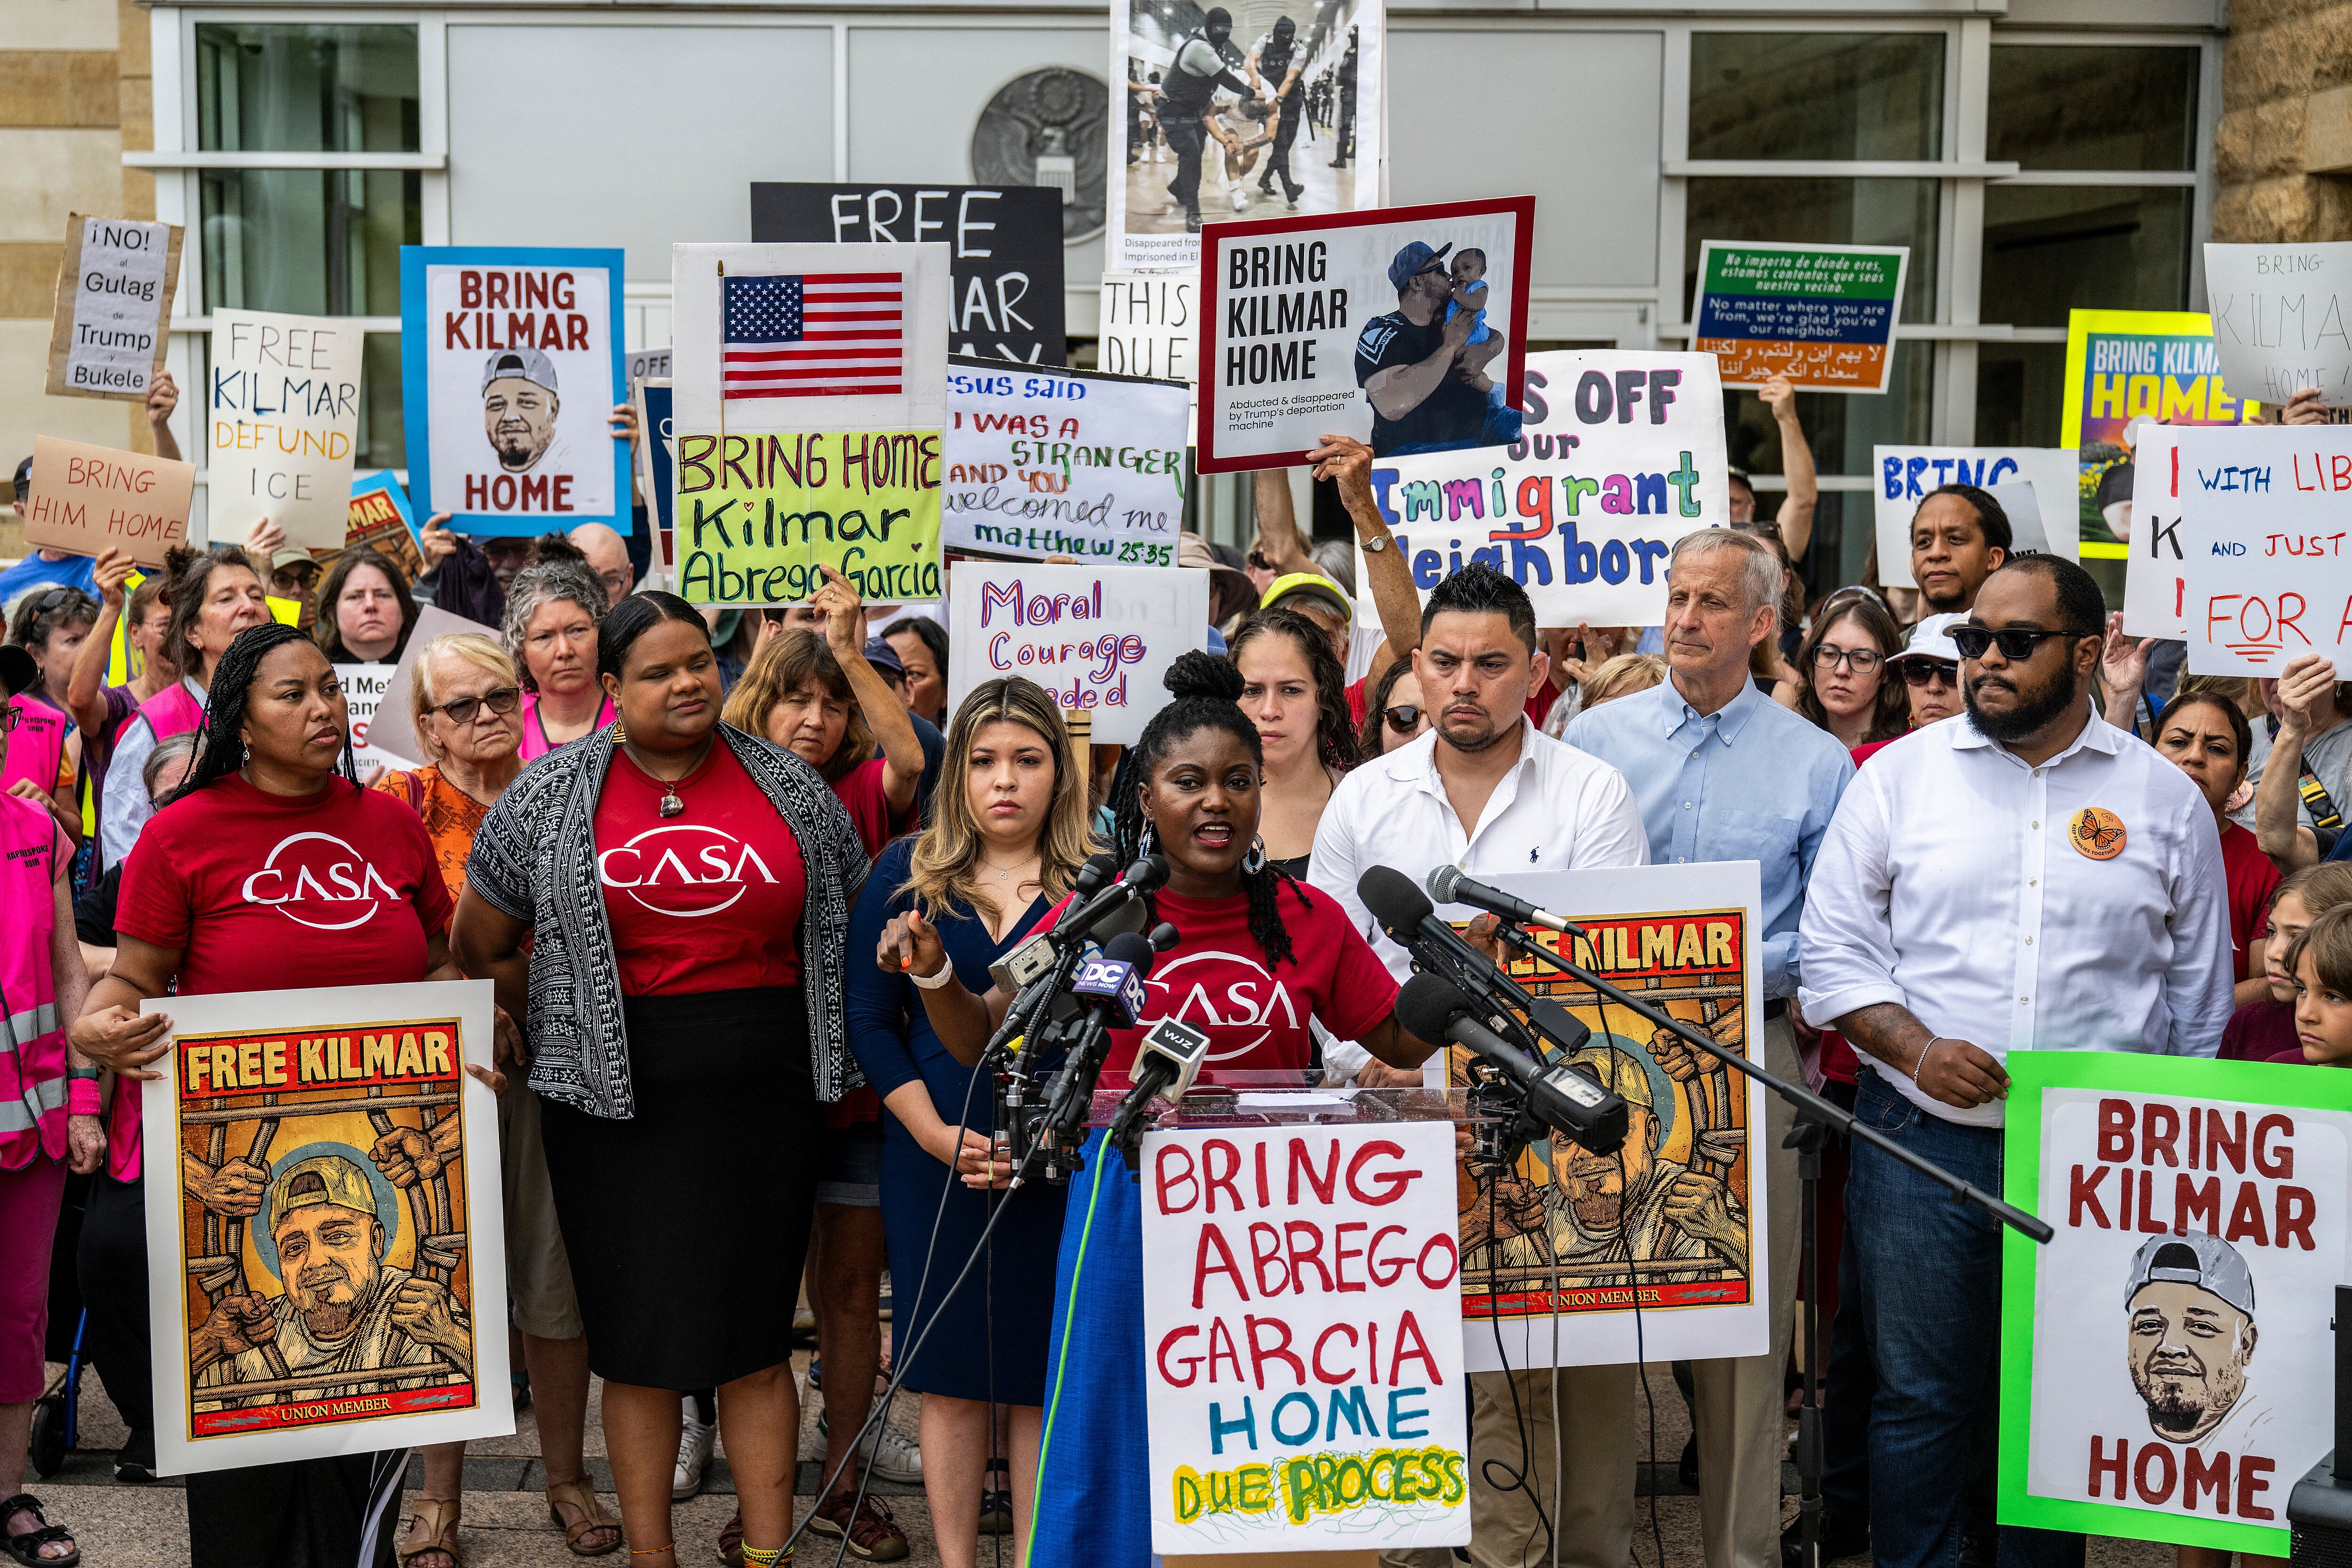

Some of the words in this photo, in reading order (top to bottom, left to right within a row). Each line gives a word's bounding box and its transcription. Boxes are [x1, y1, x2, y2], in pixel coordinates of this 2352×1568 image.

[831, 189, 1003, 258] FREE
[1125, 238, 1182, 248] Disappeared
[1125, 252, 1176, 262] Imprisoned
[1179, 252, 1188, 261] in
[119, 259, 127, 267] al
[1229, 240, 1327, 290] BRING
[1721, 266, 1769, 279] estamos
[1772, 268, 1829, 281] contentos
[1833, 272, 1854, 284] que
[1859, 272, 1885, 283] seas
[1725, 253, 1742, 266] No
[1745, 255, 1792, 270] importa
[1796, 255, 1811, 270] de
[1814, 255, 1850, 270] dónde
[1853, 260, 1882, 273] eres,
[2257, 254, 2324, 275] BRING
[86, 271, 156, 302] Gulag
[460, 270, 576, 310] BRING
[949, 271, 1034, 333] AR
[1104, 281, 1190, 327] THIS
[1755, 280, 1800, 292] nuestro
[1804, 280, 1845, 294] vecino.
[113, 311, 124, 320] de
[1228, 288, 1348, 339] KILMAR
[1709, 297, 1730, 310] No
[1734, 298, 1782, 312] matter
[1786, 300, 1829, 314] where
[1833, 305, 1859, 316] you
[1863, 304, 1886, 316] are
[1714, 309, 1750, 324] from,
[1798, 311, 1829, 327] glad
[2213, 292, 2351, 350] KILMA
[77, 323, 151, 352] Trump
[232, 323, 336, 370] FREE
[445, 312, 589, 350] KILMAR
[1749, 324, 1773, 335] our
[1777, 322, 1843, 339] neighbor.
[109, 353, 115, 362] y
[633, 355, 670, 377] OFF
[1108, 336, 1188, 379] DUE
[1226, 339, 1317, 387] HOME
[1868, 345, 1882, 362] لا
[2093, 340, 2157, 373] BRING
[74, 365, 143, 388] Bukele
[215, 367, 356, 420] KILMAR
[947, 375, 1014, 396] sus
[1229, 397, 1279, 410] Abducted
[1290, 389, 1355, 406] disappeared
[1229, 412, 1242, 422] by
[1244, 407, 1284, 419] Trump's
[1286, 402, 1345, 416] deportation
[1575, 369, 1683, 425] OFF
[2091, 373, 2236, 421] HOME
[216, 421, 350, 460] DEFUND
[954, 412, 962, 429] I
[973, 413, 1049, 438] WAS
[1058, 418, 1079, 439] A
[1229, 420, 1274, 431] machine
[68, 457, 156, 493] BRING
[678, 432, 827, 494] BRING
[842, 432, 941, 495] HOME
[949, 462, 1008, 484] AND
[1017, 468, 1068, 495] YOU
[1012, 440, 1184, 499] STRANGER
[2198, 465, 2271, 494] WITH
[252, 468, 312, 501] ICE
[465, 474, 574, 512] HOME
[1370, 451, 1701, 543] Immigrant
[32, 494, 86, 529] HIM
[109, 511, 183, 540] HOME
[346, 496, 395, 533] MAR
[693, 497, 911, 549] Kilmar
[945, 486, 1114, 529] welcomed
[1122, 507, 1170, 533] me
[1117, 541, 1174, 568] 25:35
[1396, 522, 1682, 590] eihbor
[2211, 541, 2247, 557] AND
[681, 549, 830, 603] Abrego
[841, 546, 941, 598] Garcia
[981, 579, 1101, 628] Moral
[2208, 591, 2312, 646] FOR
[989, 631, 1147, 684] Courage
[357, 677, 391, 694] Me
[354, 758, 380, 767] OCIETY
[2101, 812, 2113, 822] CASA
[2073, 836, 2090, 853] FAMILIES
[2091, 847, 2116, 856] TOGETHER
[242, 862, 401, 904] CASA
[597, 843, 779, 888] CASA
[1492, 931, 1560, 975] EE
[1574, 922, 1733, 971] KILMAR
[1164, 1029, 1194, 1050] WJZ
[188, 1041, 287, 1091] FREE
[299, 1031, 452, 1082] KILMAR
[2097, 1097, 2296, 1180] BRING
[1155, 1137, 1423, 1215] BRING
[2068, 1163, 2317, 1252] KILMAR
[1192, 1220, 1460, 1309] ABREGO
[1547, 1292, 1596, 1307] UNION
[1599, 1289, 1662, 1304] MEMBER
[1156, 1309, 1444, 1391] GARCIA
[281, 1405, 329, 1422] UNION
[332, 1397, 392, 1416] MEMBER
[1209, 1385, 1430, 1455] HOME
[1178, 1466, 1270, 1520] DUE
[1288, 1449, 1467, 1521] PROCESS
[2087, 1434, 2277, 1521] HOME
